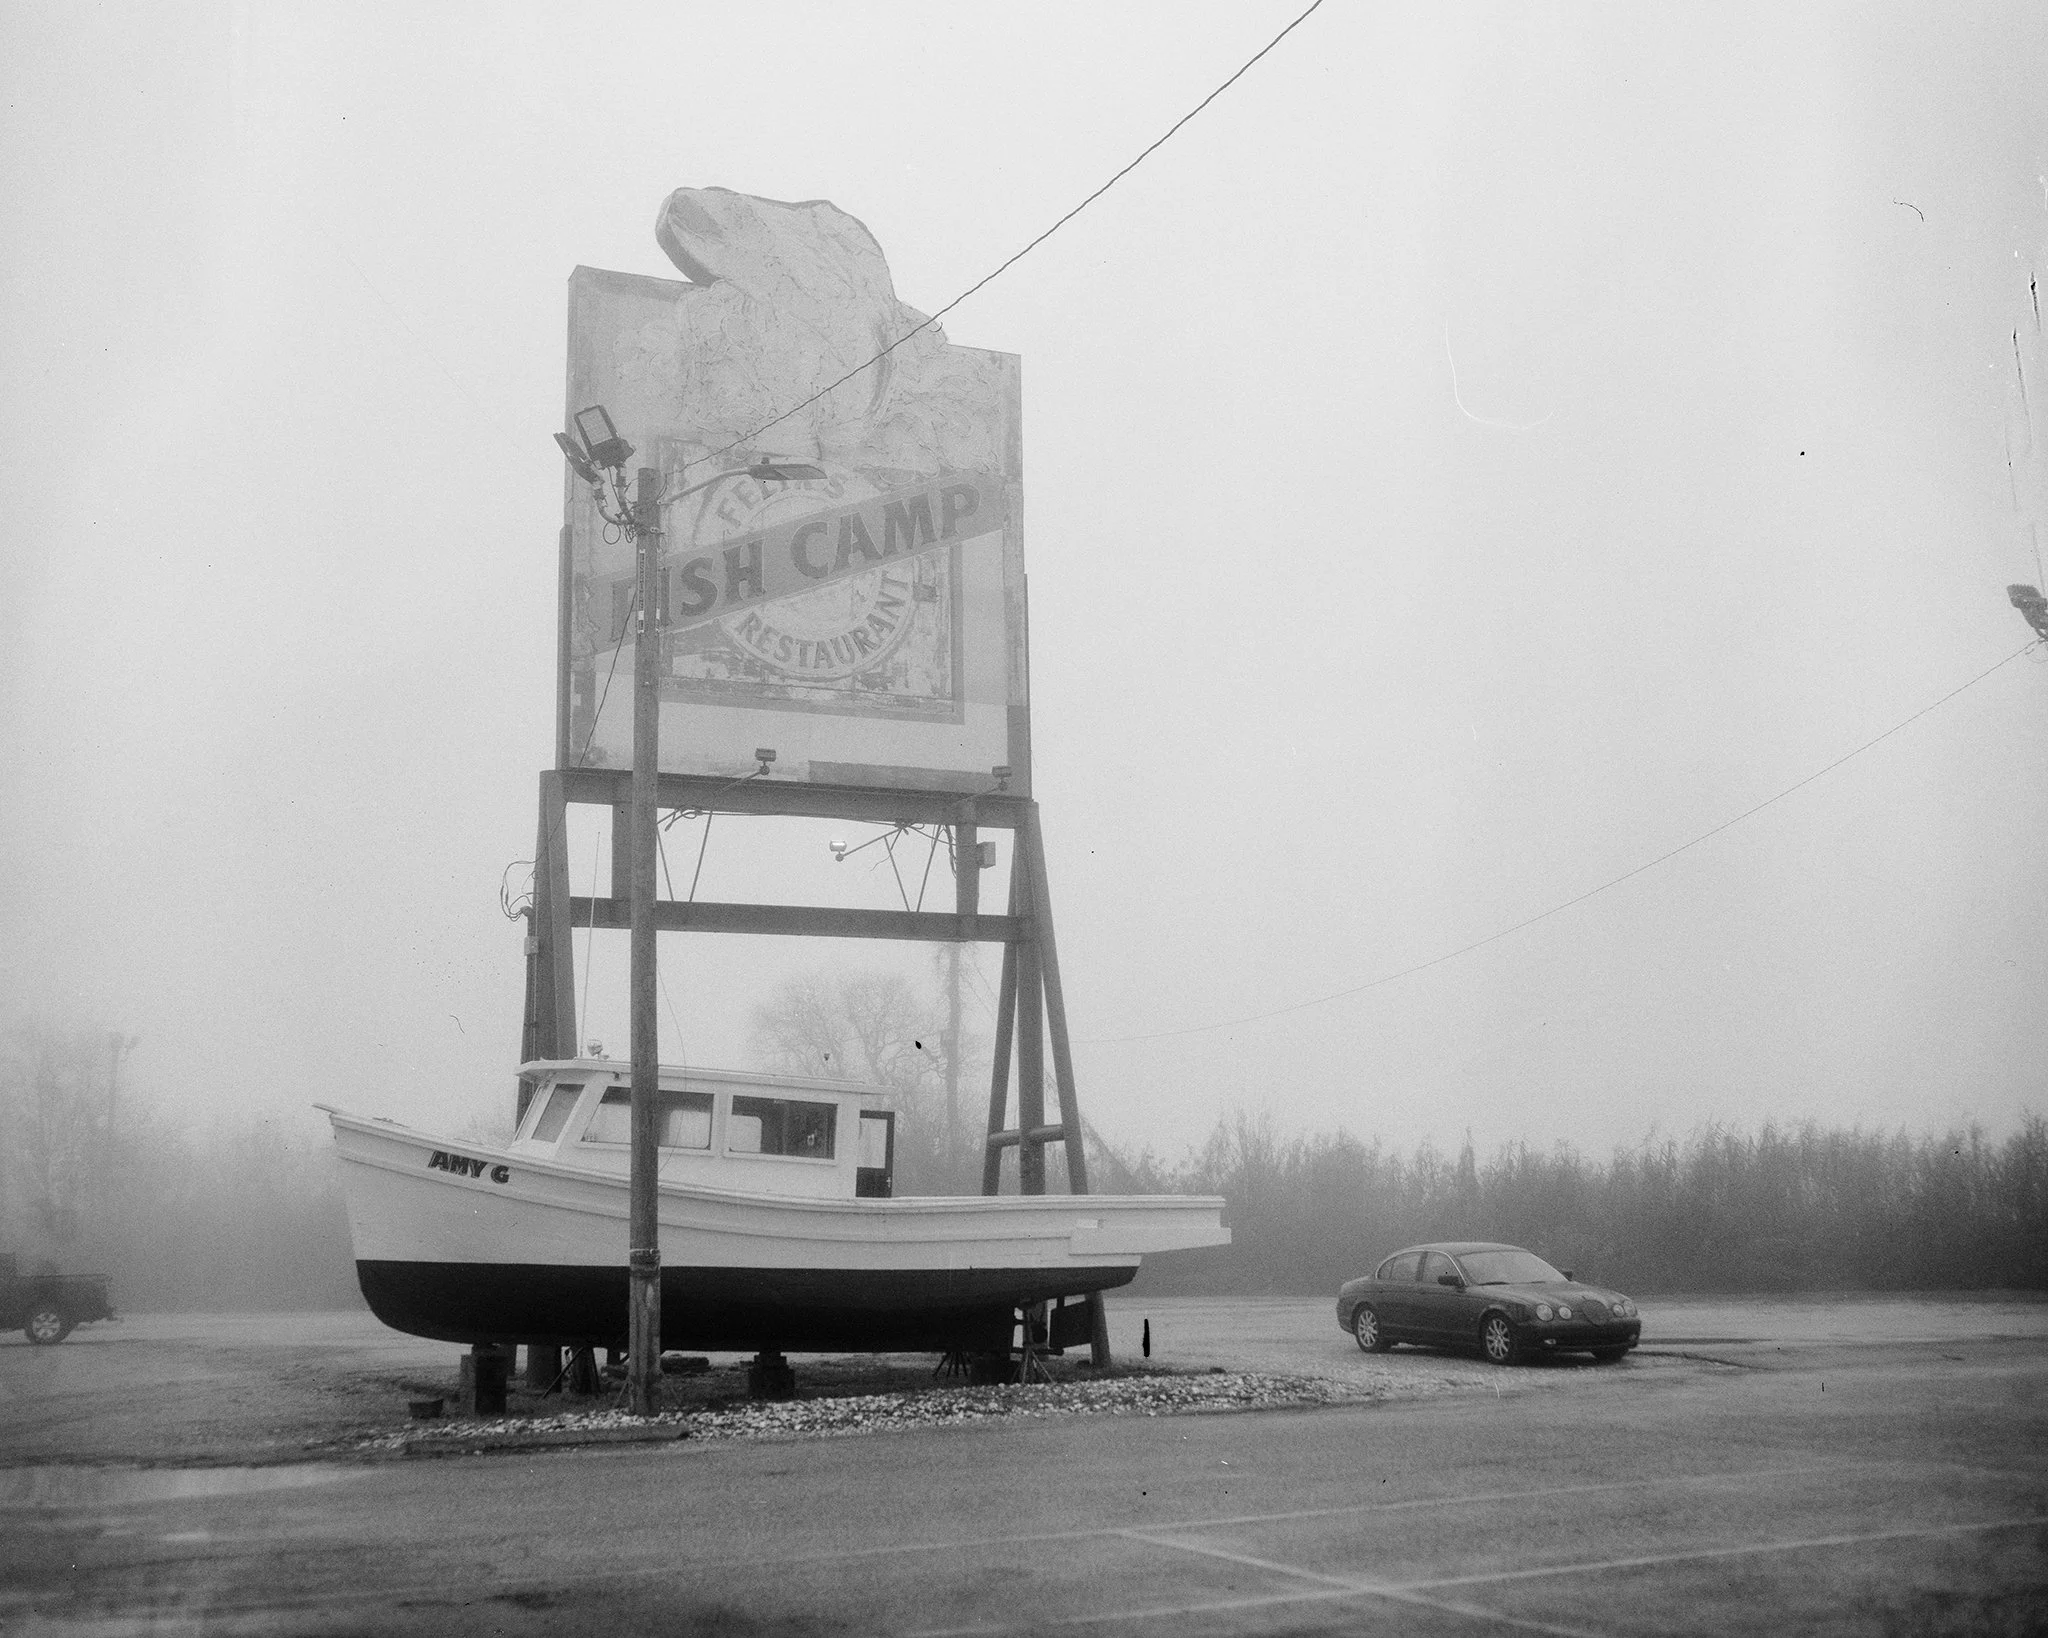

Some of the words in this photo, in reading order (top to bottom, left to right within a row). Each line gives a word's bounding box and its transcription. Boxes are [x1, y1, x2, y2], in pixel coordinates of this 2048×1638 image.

[790, 484, 980, 579] CAMP
[734, 570, 909, 670] RESTAURANT
[428, 1150, 488, 1179] AMY
[490, 1165, 510, 1184] G
